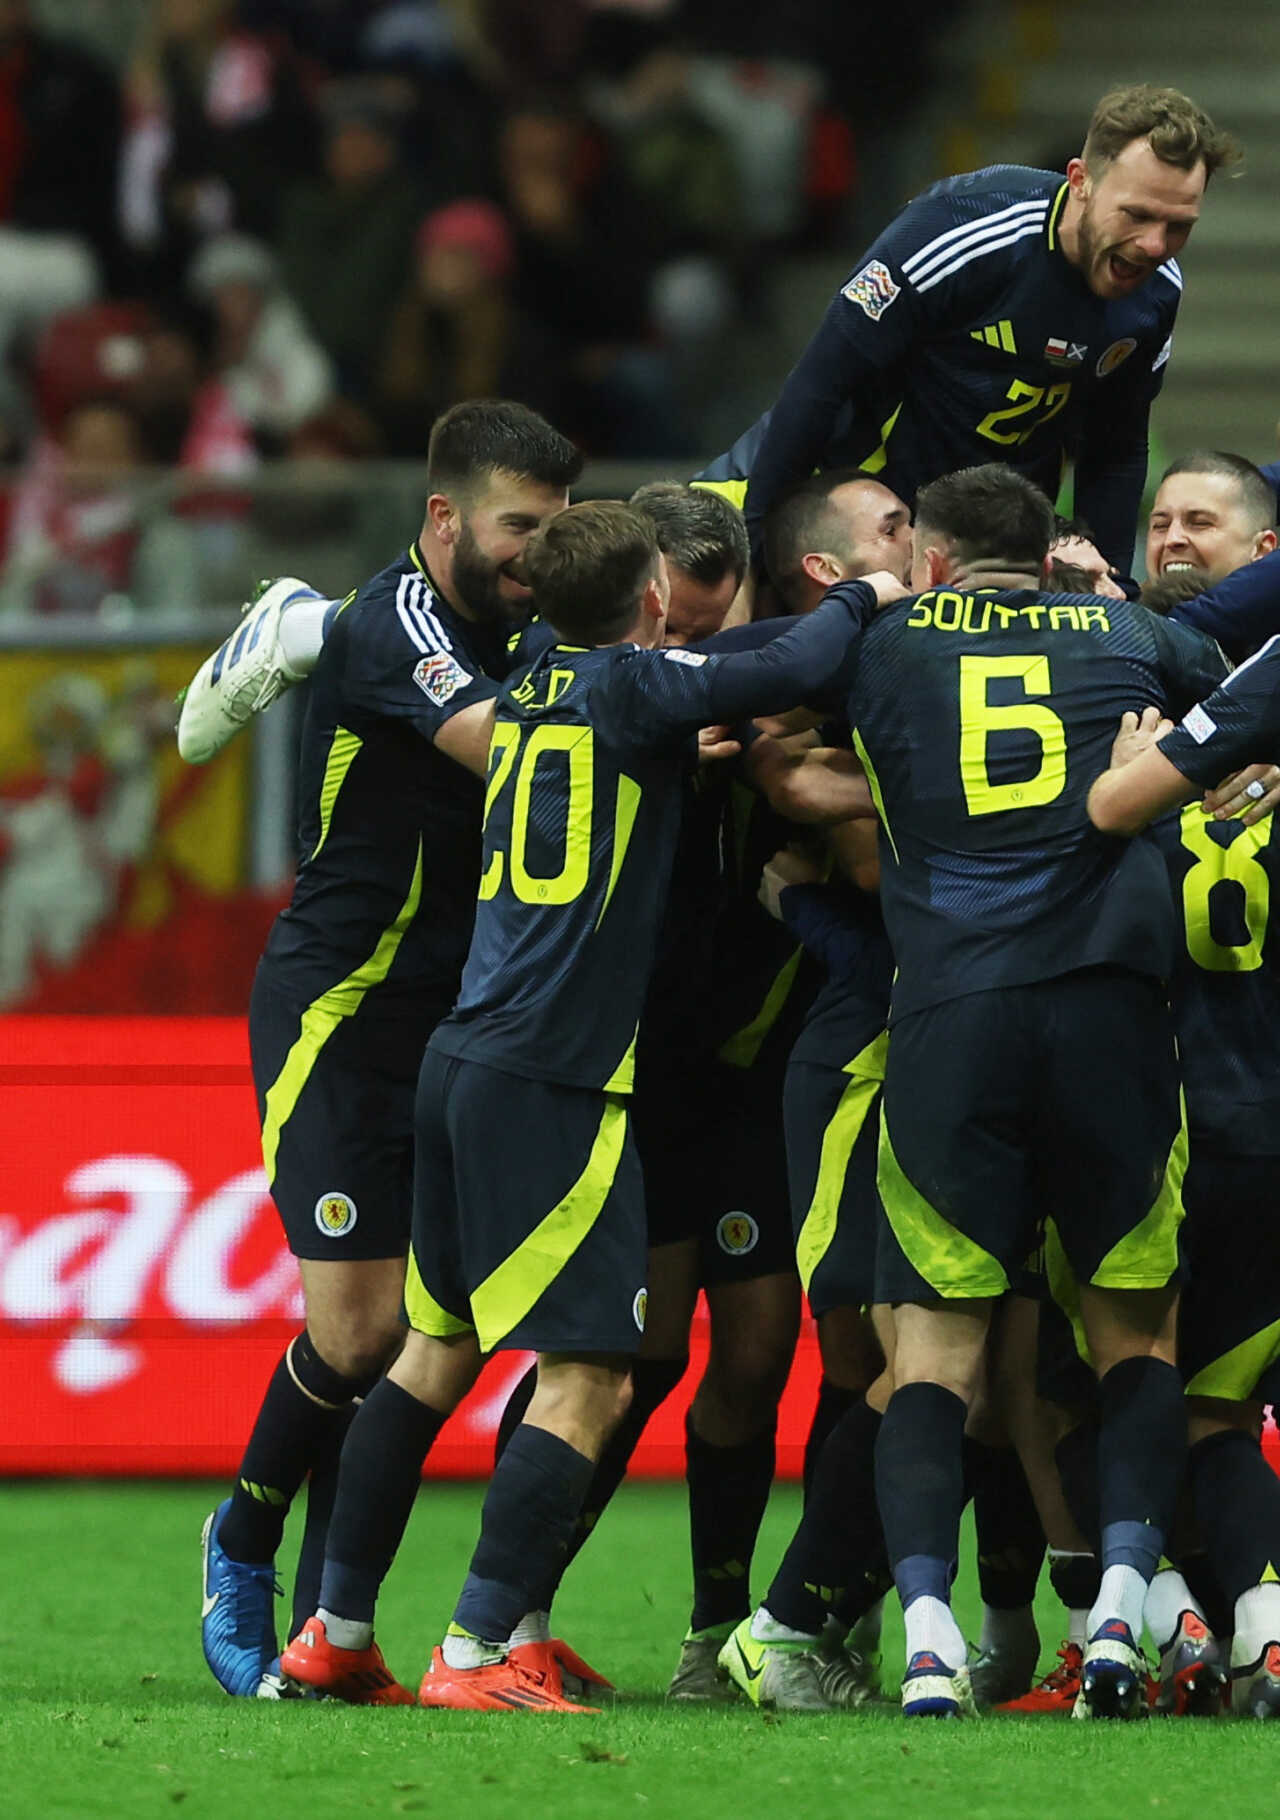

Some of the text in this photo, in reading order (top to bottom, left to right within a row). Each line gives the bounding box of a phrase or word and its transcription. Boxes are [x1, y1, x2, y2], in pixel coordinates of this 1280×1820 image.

[907, 591, 1110, 634] SOUTTAR
[478, 721, 594, 905] 20
[959, 655, 1068, 816] 6
[1179, 800, 1274, 972] 8
